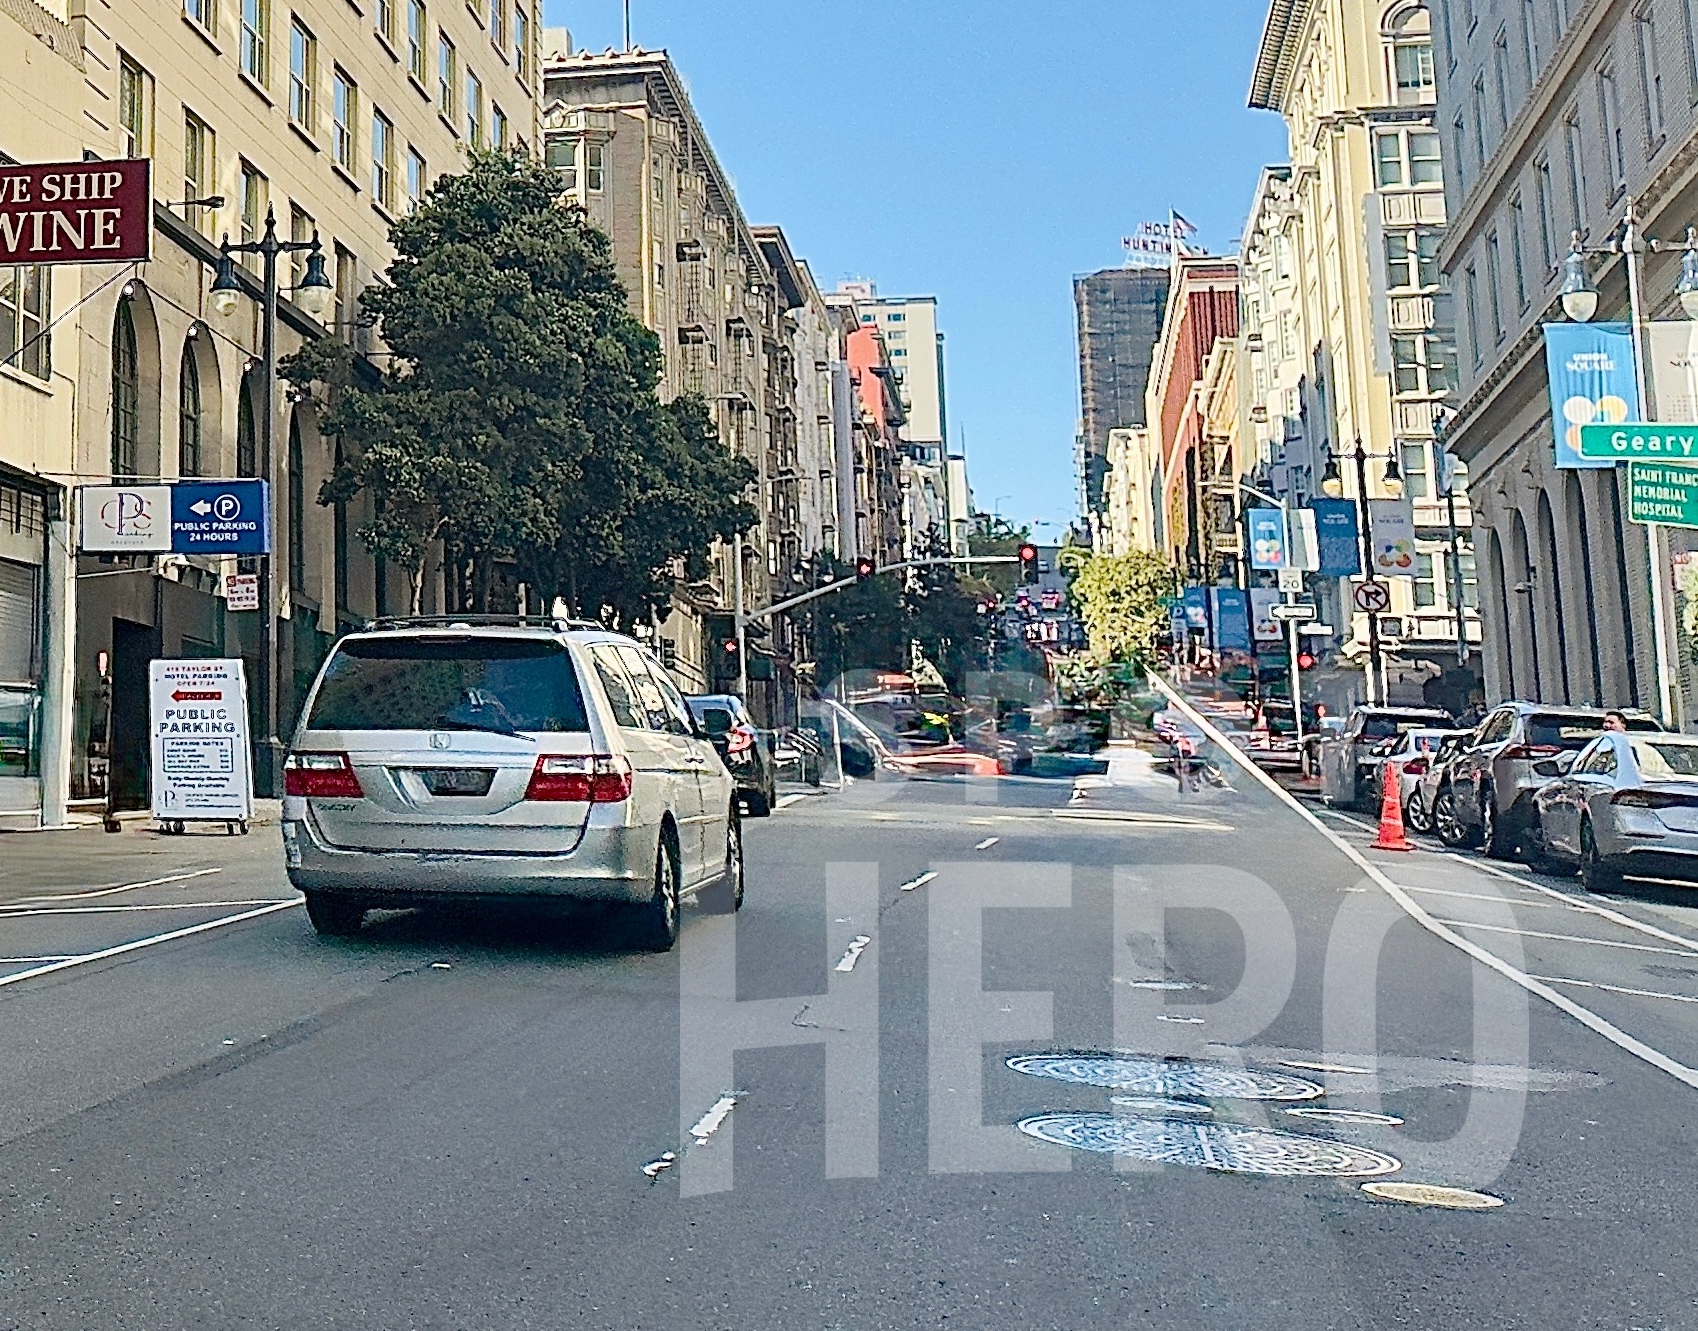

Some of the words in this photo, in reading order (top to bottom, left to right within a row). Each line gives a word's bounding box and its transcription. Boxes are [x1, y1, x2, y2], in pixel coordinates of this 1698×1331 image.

[41, 171, 123, 202] SHIP
[1573, 352, 1608, 361] UNION
[1566, 360, 1614, 372] SQUARE
[1611, 431, 1694, 456] Geary
[1634, 468, 1662, 483] SAINT
[1634, 485, 1688, 503] MEMORIAL
[1634, 501, 1684, 520] HOSPITAL
[174, 522, 210, 531] PUBLIC
[212, 521, 257, 531] PARKING
[189, 532, 201, 542] 24
[203, 532, 239, 542] HOURS
[1283, 579, 1300, 589] 20
[165, 708, 227, 720] PUBLIC
[159, 721, 236, 733] PARKING
